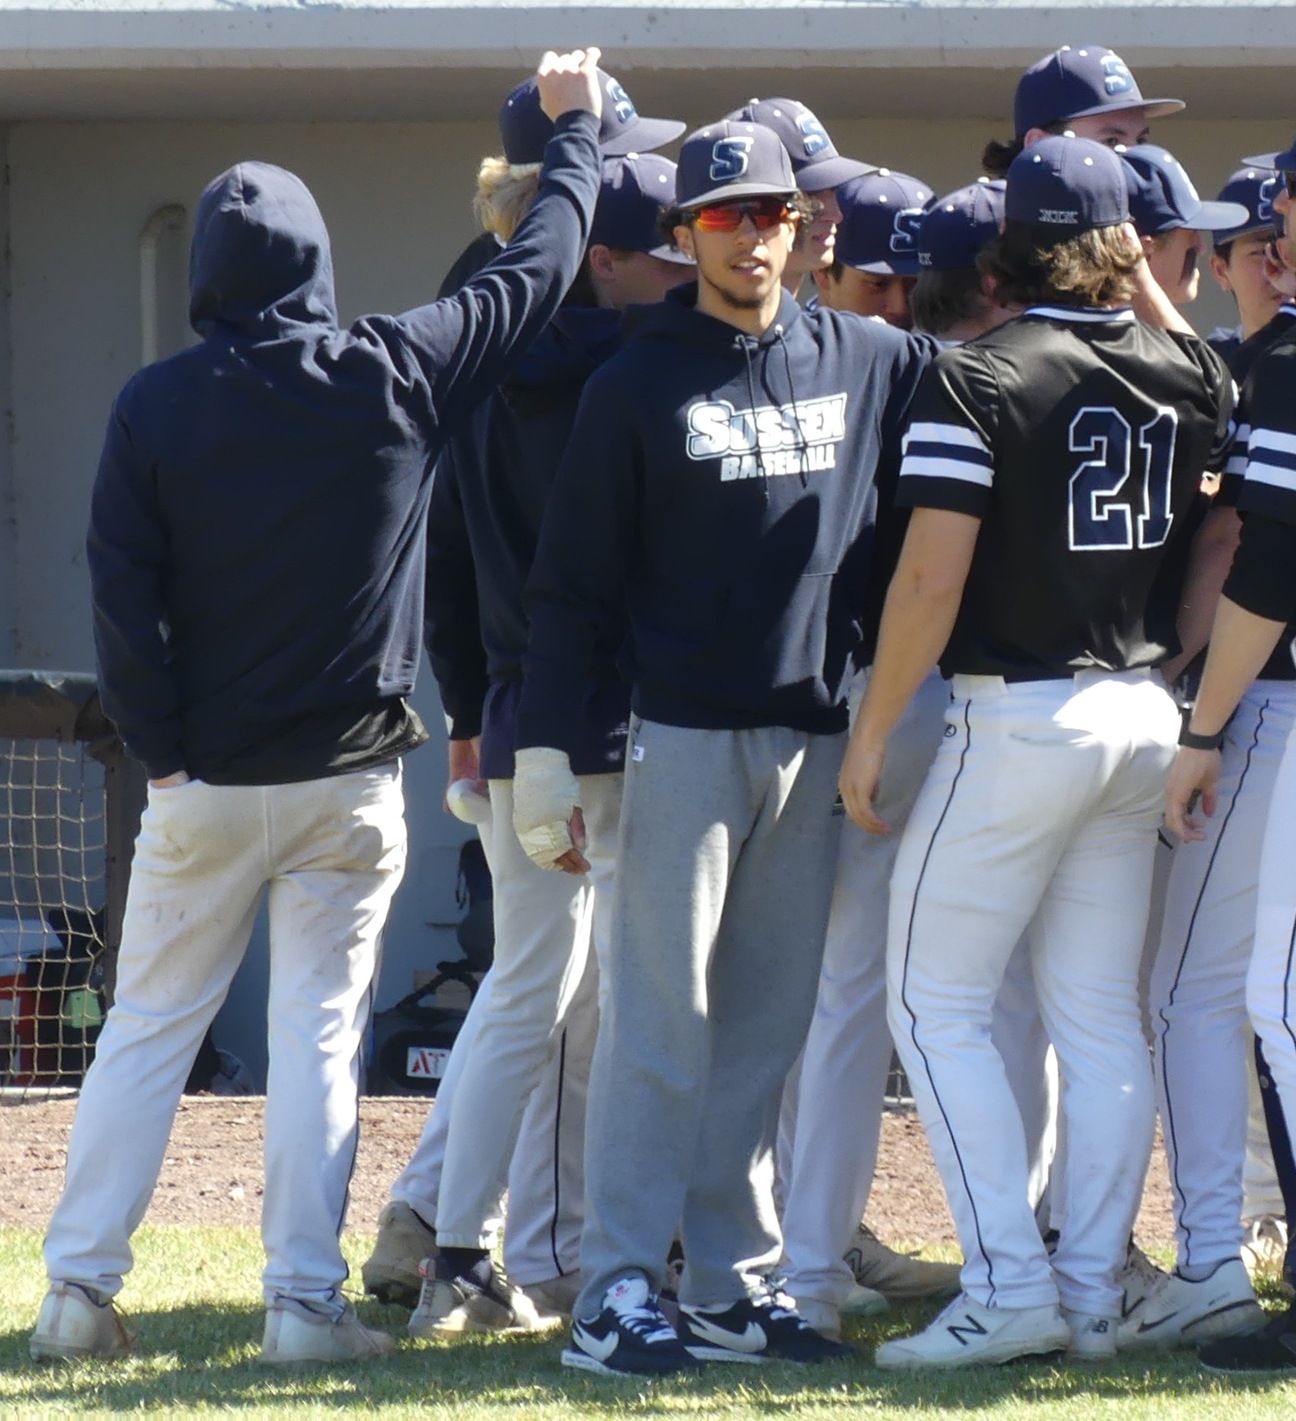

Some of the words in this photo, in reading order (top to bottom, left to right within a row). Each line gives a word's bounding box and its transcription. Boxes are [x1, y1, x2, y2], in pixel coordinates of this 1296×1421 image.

[709, 136, 754, 181] S
[686, 392, 848, 461] SUSSEX
[720, 443, 836, 482] BASEBALL
[1068, 406, 1178, 551] 21
